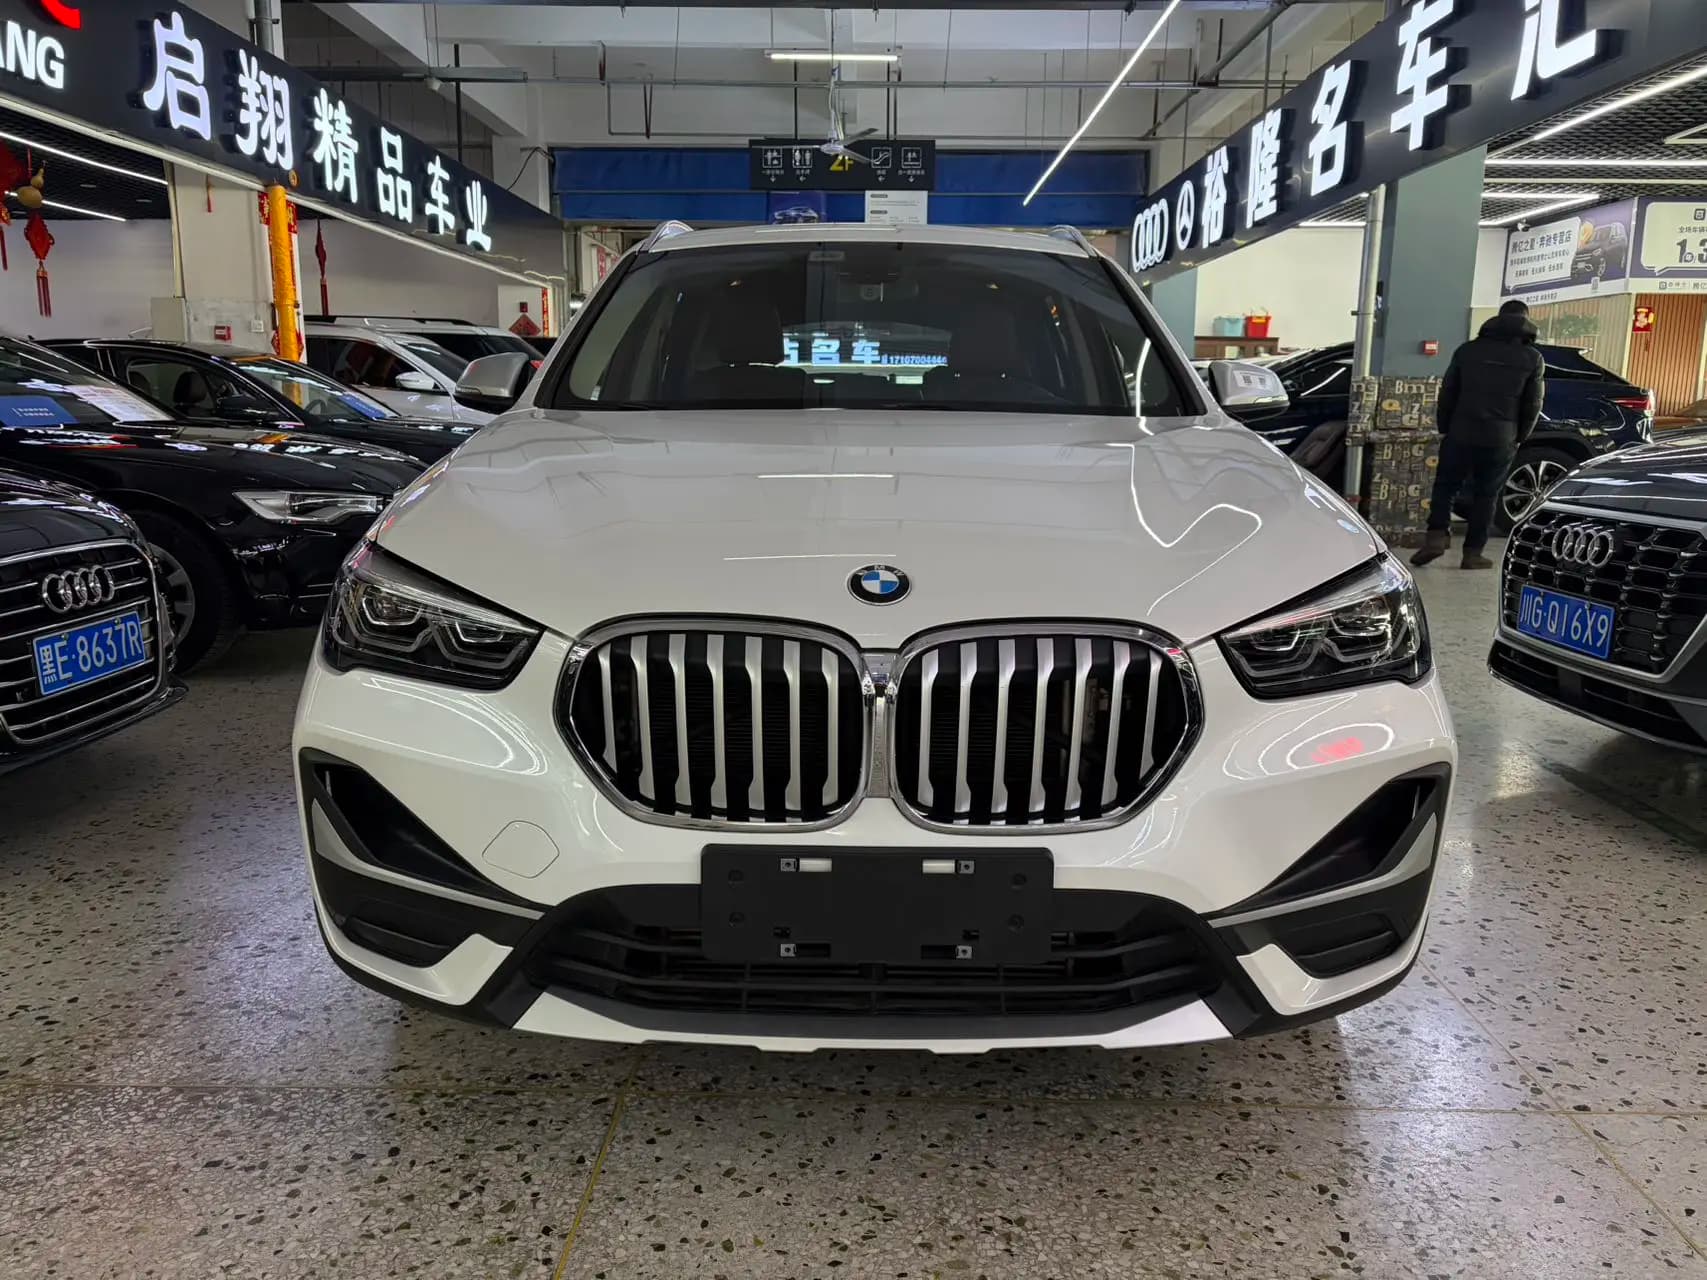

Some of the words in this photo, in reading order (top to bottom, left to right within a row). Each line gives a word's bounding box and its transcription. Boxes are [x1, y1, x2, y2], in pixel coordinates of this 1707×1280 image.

[0, 20, 65, 90] NG
[143, 11, 492, 252] 启翔精品车业
[39, 620, 142, 685] 黑E·8637R
